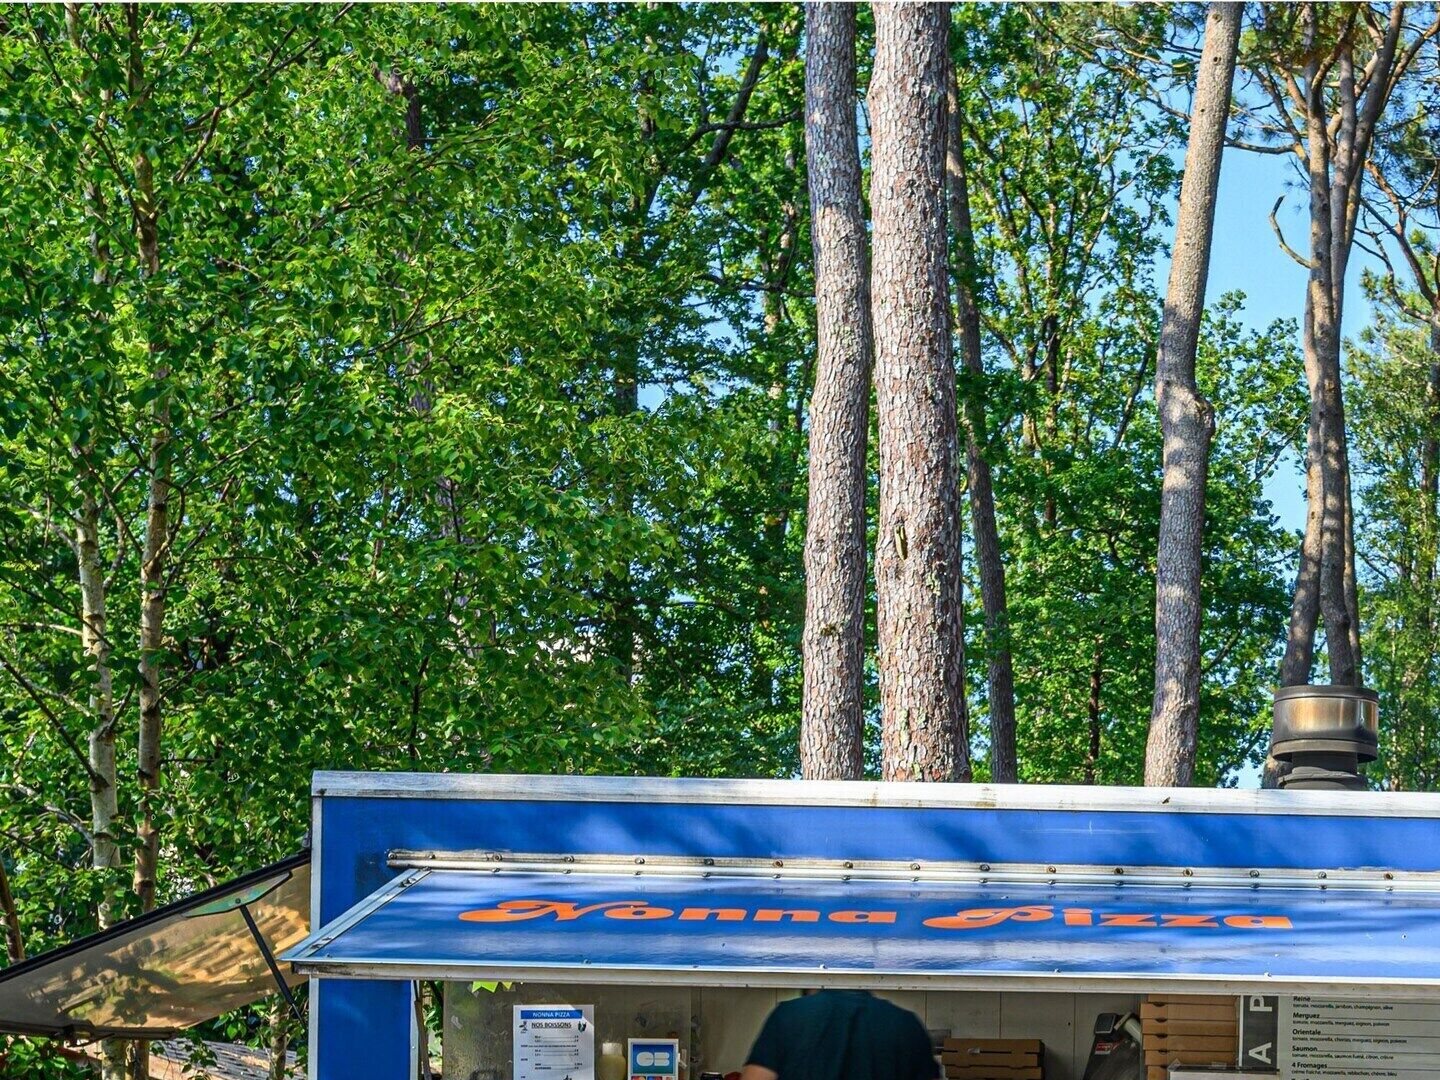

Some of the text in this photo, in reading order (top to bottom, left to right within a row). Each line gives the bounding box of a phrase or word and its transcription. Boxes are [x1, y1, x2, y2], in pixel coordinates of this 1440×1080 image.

[458, 899, 1294, 930] Nonna Pizza
[1292, 1012, 1320, 1020] Merguez
[1296, 1062, 1328, 1070] Fromages
